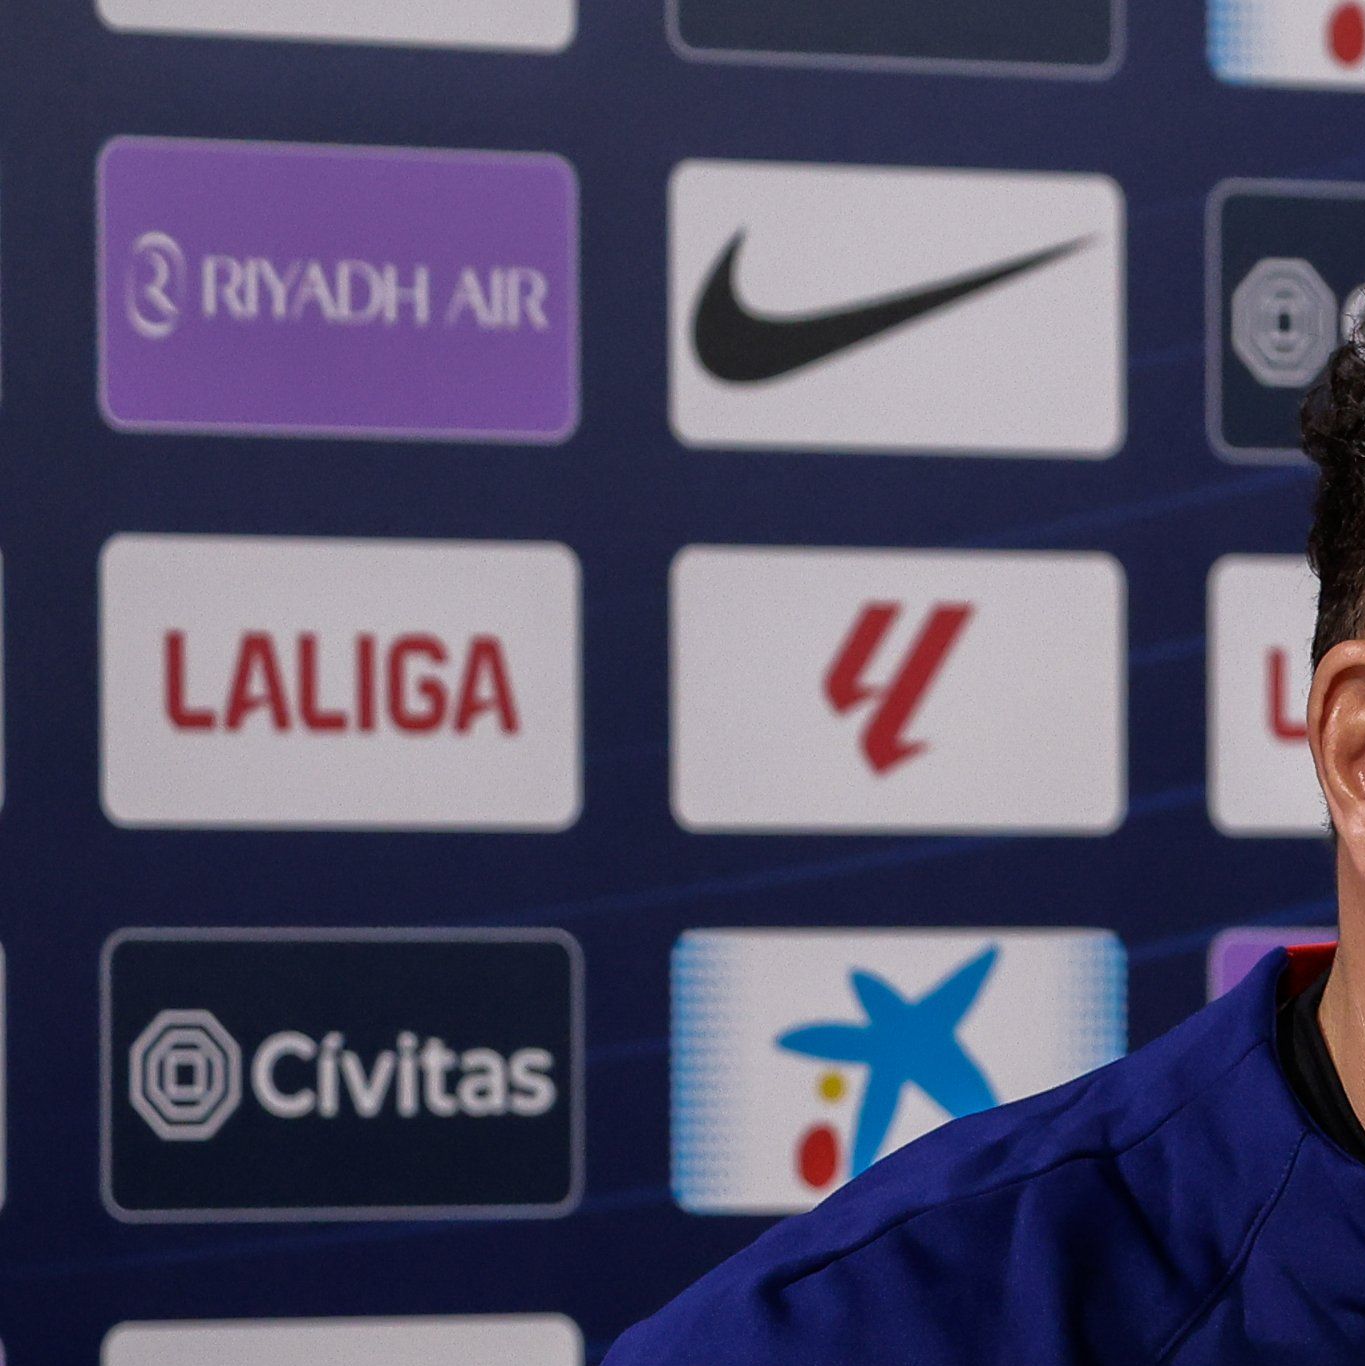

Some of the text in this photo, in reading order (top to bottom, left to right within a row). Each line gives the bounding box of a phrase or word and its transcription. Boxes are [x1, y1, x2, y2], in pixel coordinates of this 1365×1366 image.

[202, 256, 547, 329] RIYADH AIR
[164, 630, 519, 735] LALIGA
[252, 1032, 555, 1117] Cívitas
